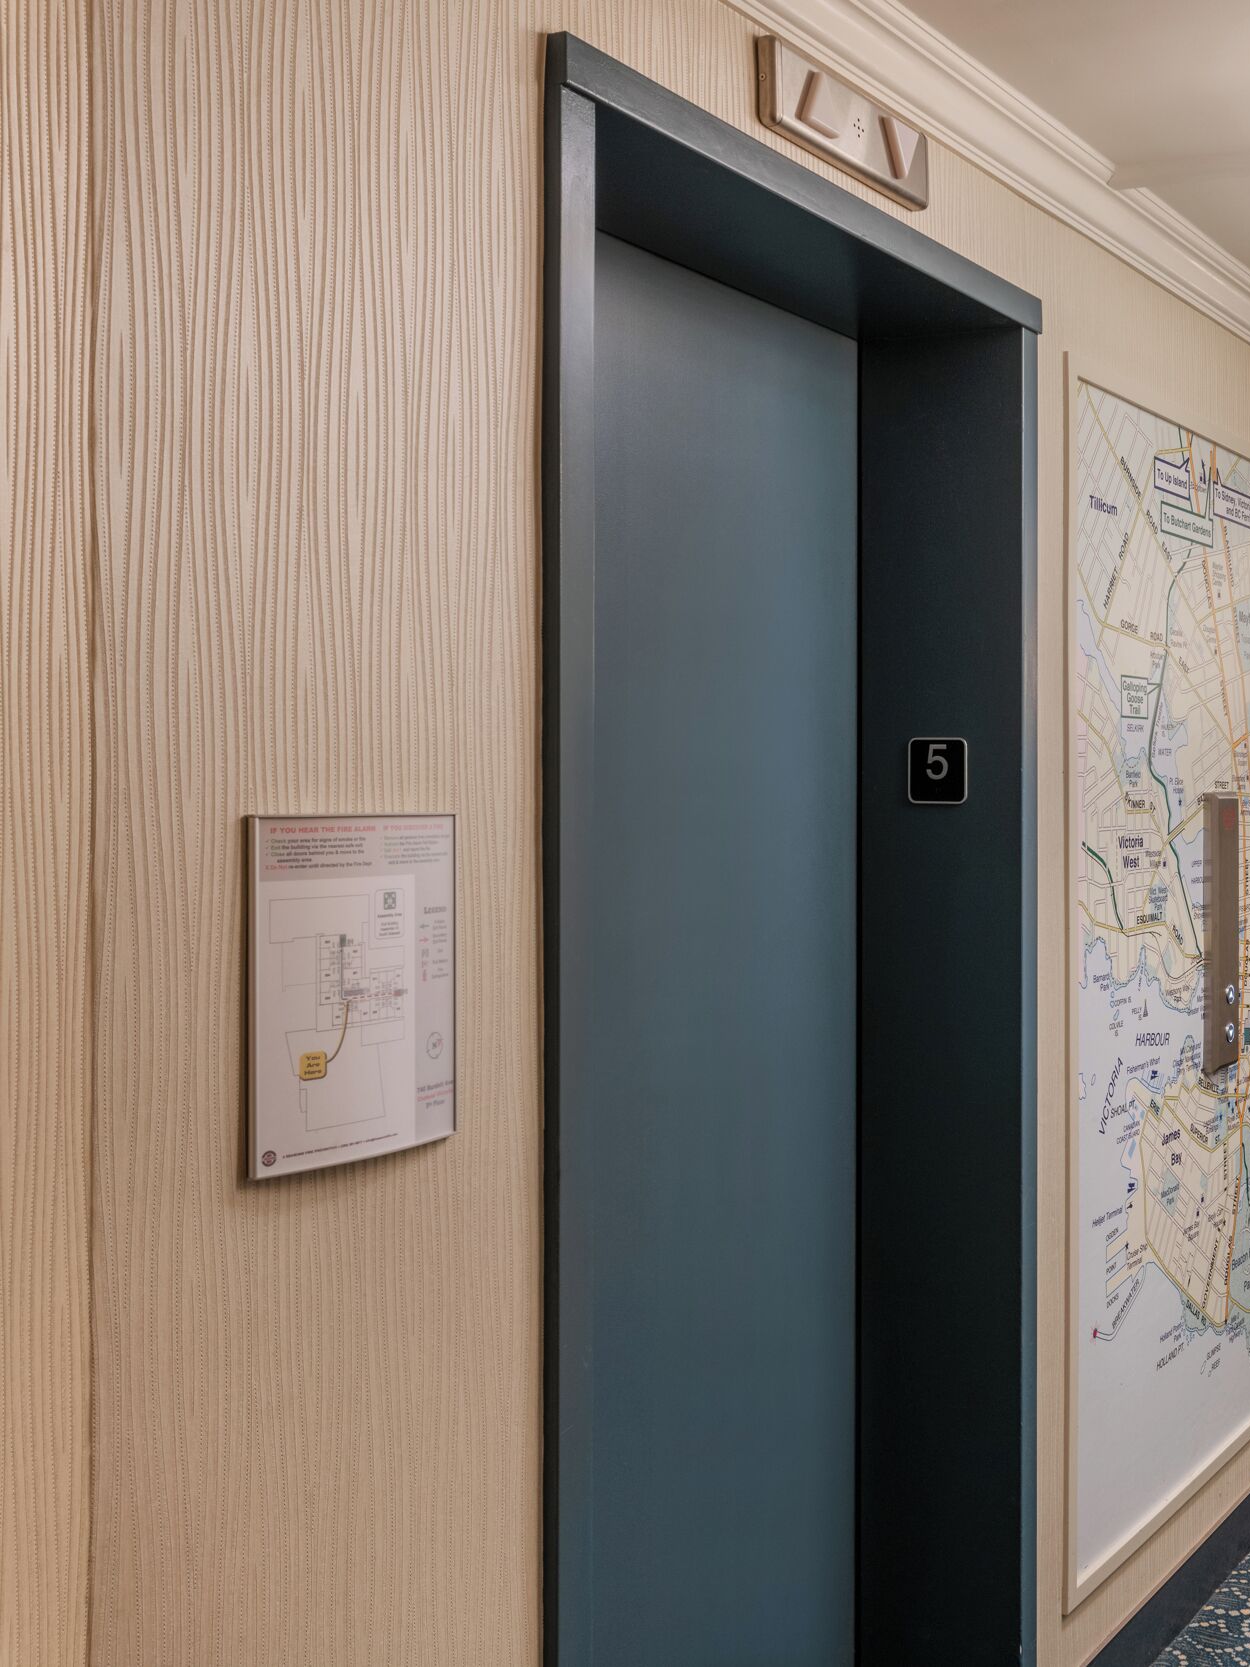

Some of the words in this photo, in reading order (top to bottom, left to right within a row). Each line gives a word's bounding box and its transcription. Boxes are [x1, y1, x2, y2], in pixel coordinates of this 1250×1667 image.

[1157, 468, 1164, 480] To
[1164, 472, 1172, 485] Up
[1173, 474, 1187, 490] Island
[1215, 487, 1221, 499] To
[1089, 494, 1118, 517] Tillicum
[1119, 455, 1142, 501] BURNSIDE
[1146, 509, 1158, 536] ROAD
[1161, 540, 1173, 563] EAST
[1226, 506, 1235, 517] and
[1234, 508, 1241, 520] BC
[1163, 512, 1170, 524] To
[1171, 514, 1191, 531] Butchart
[1192, 522, 1211, 538] Gardens
[1103, 564, 1117, 611] HARRIET
[1118, 531, 1129, 561] ROAD
[1201, 559, 1213, 610] DOUGLAS
[1120, 618, 1139, 635] GORGE
[1149, 631, 1164, 642] ROAD
[1122, 680, 1148, 694] Galloping
[1126, 693, 1144, 705] Goose
[1129, 704, 1141, 715] Trail
[926, 744, 949, 780] 5
[280, 826, 297, 834] YOU
[299, 826, 319, 834] HEAR
[320, 825, 336, 833] THE
[290, 843, 311, 851] building
[1117, 835, 1144, 849] Victoria
[1122, 855, 1140, 869] West
[1136, 912, 1163, 925] ESQUIMALT
[1171, 924, 1184, 946] ROAD
[1126, 1059, 1149, 1075] Fisherman's
[1149, 1055, 1161, 1069] Wharf
[1098, 1056, 1124, 1135] VICTORIA
[1134, 1032, 1171, 1047] HARBOUR
[1110, 1104, 1129, 1120] SHOAL
[1161, 1128, 1181, 1147] James
[1170, 1151, 1183, 1167] Bay
[1231, 1252, 1248, 1271] Beacon
[1111, 1278, 1140, 1330] BREAKWATER
[1185, 1299, 1201, 1321] DALLAS
